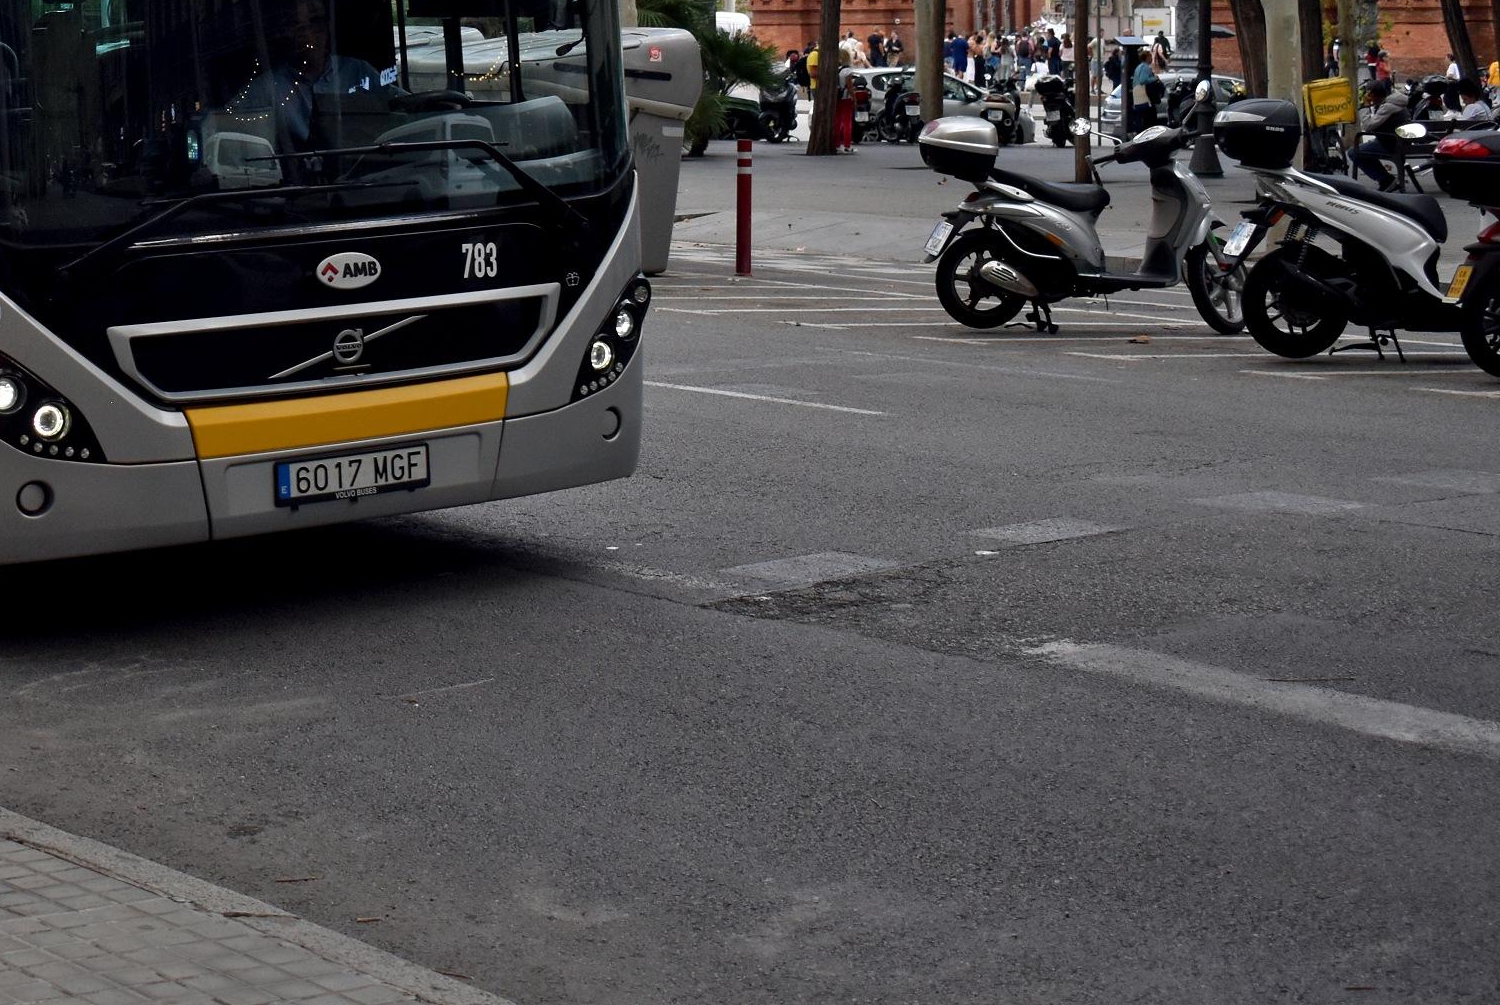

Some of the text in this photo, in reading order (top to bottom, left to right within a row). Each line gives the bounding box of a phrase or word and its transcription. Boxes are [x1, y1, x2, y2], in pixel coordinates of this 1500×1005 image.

[461, 242, 498, 279] 783
[342, 260, 378, 279] AMB
[336, 343, 362, 351] VOLVO
[296, 450, 421, 494] 6017 MGF
[281, 486, 288, 494] E
[335, 486, 378, 499] VOLVO BUSES
